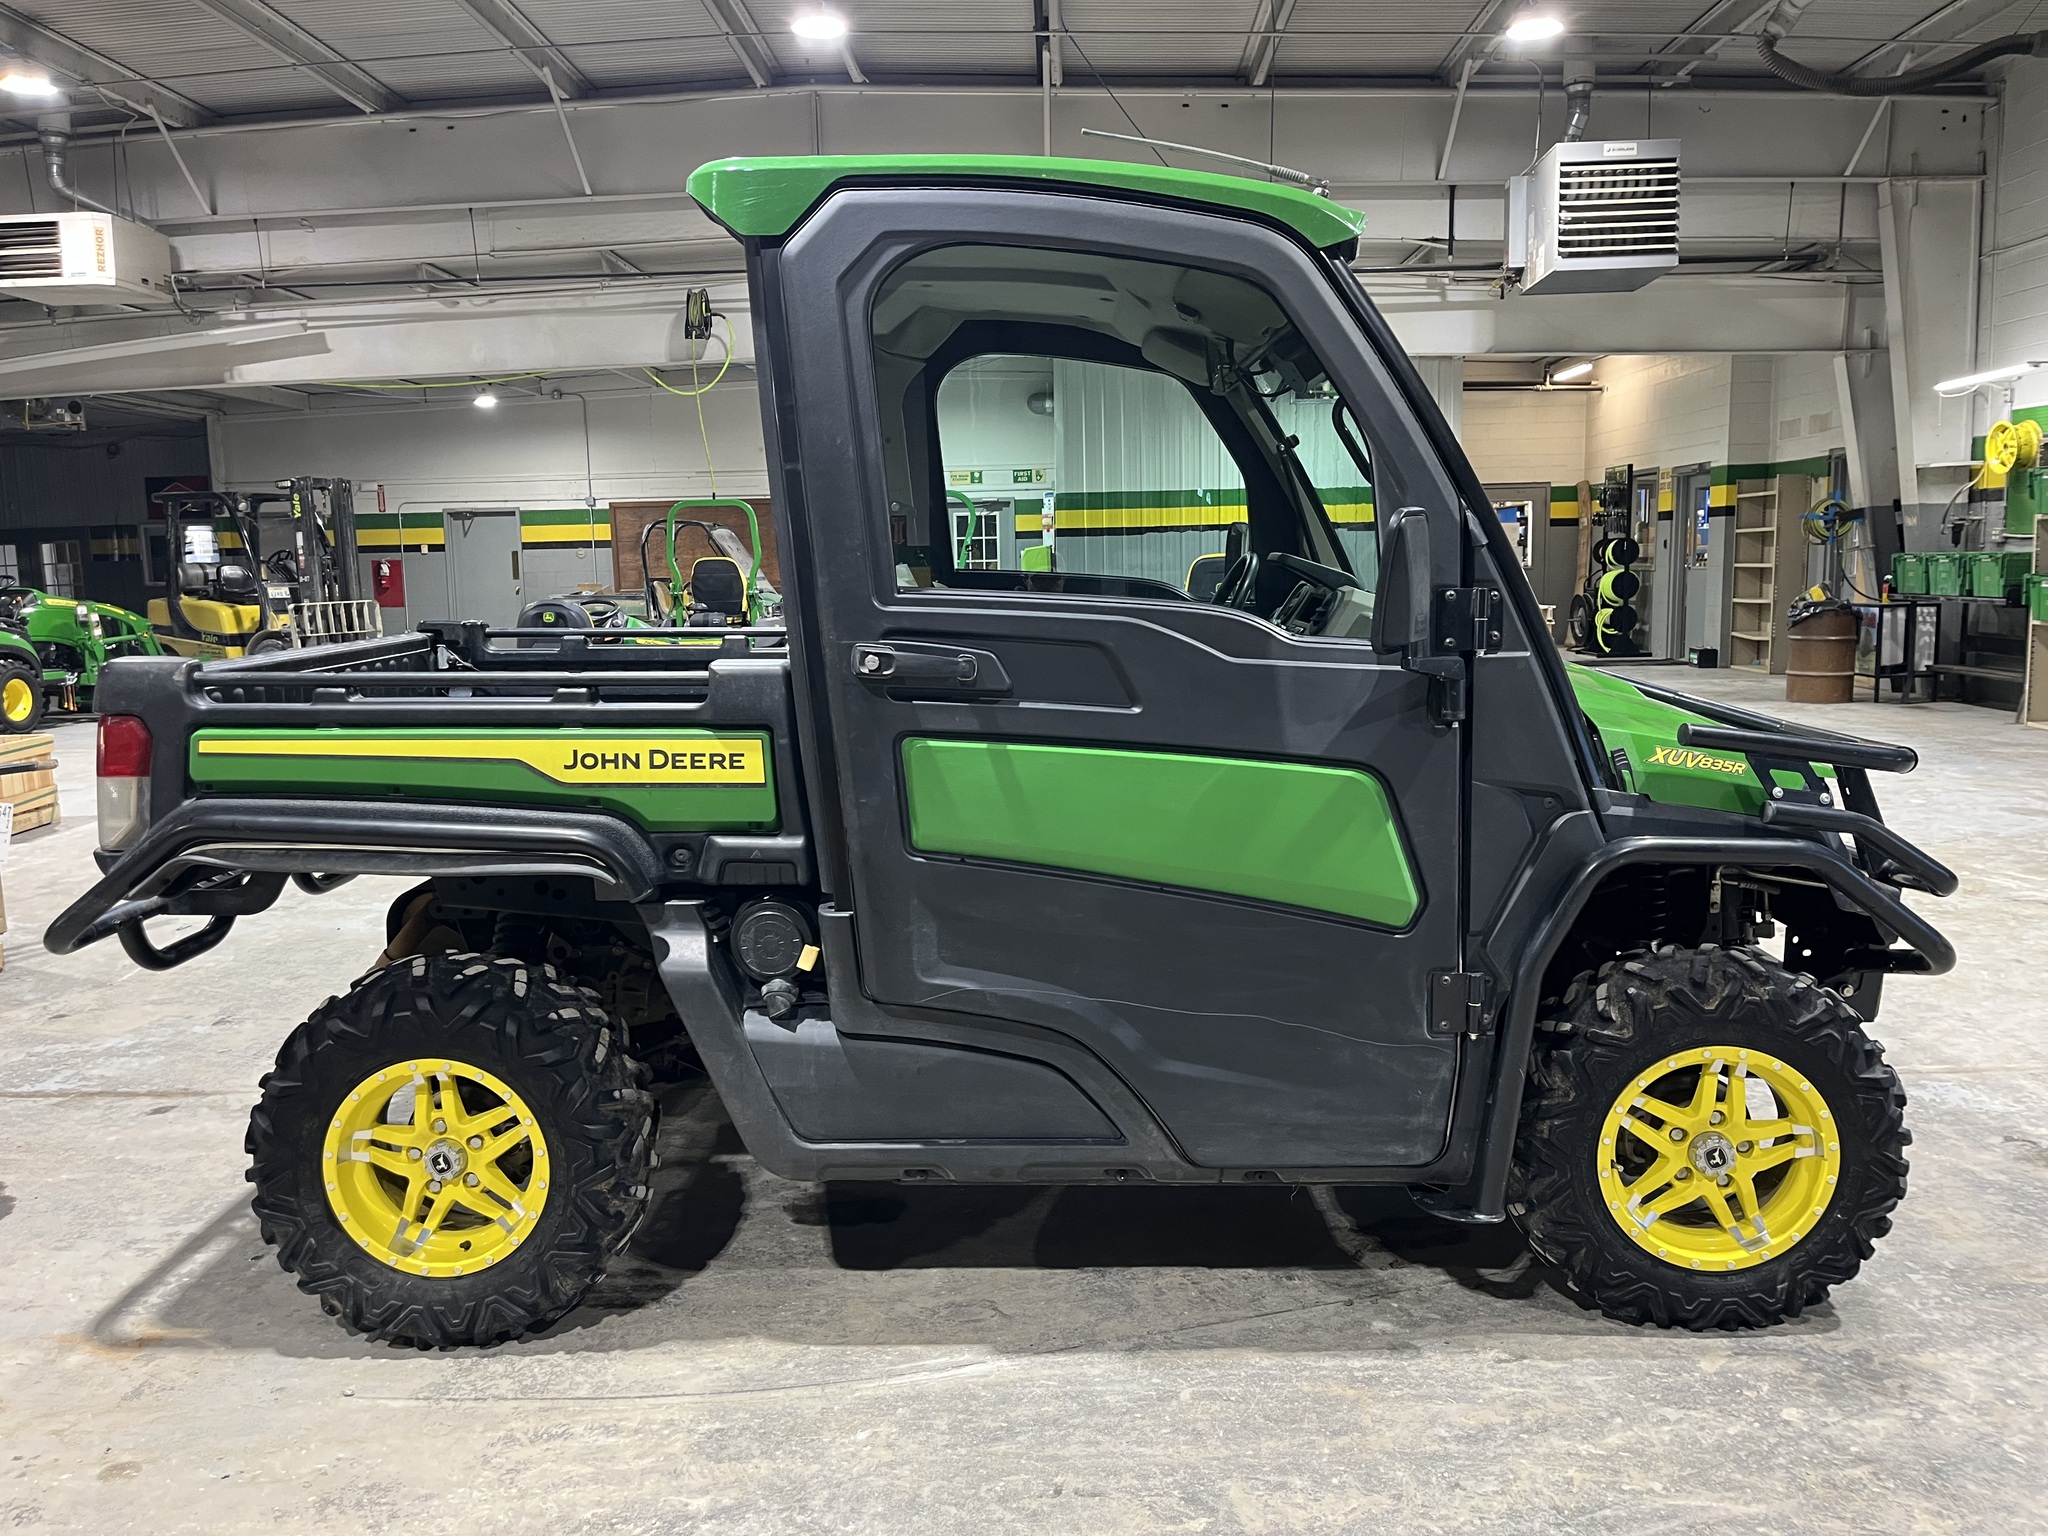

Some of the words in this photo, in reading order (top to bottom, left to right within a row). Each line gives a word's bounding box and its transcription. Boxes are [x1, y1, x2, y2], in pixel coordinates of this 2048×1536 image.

[95, 228, 106, 272] REZNOR
[292, 493, 302, 519] Yale
[201, 632, 219, 644] Yale
[1647, 746, 1747, 775] XUV835R
